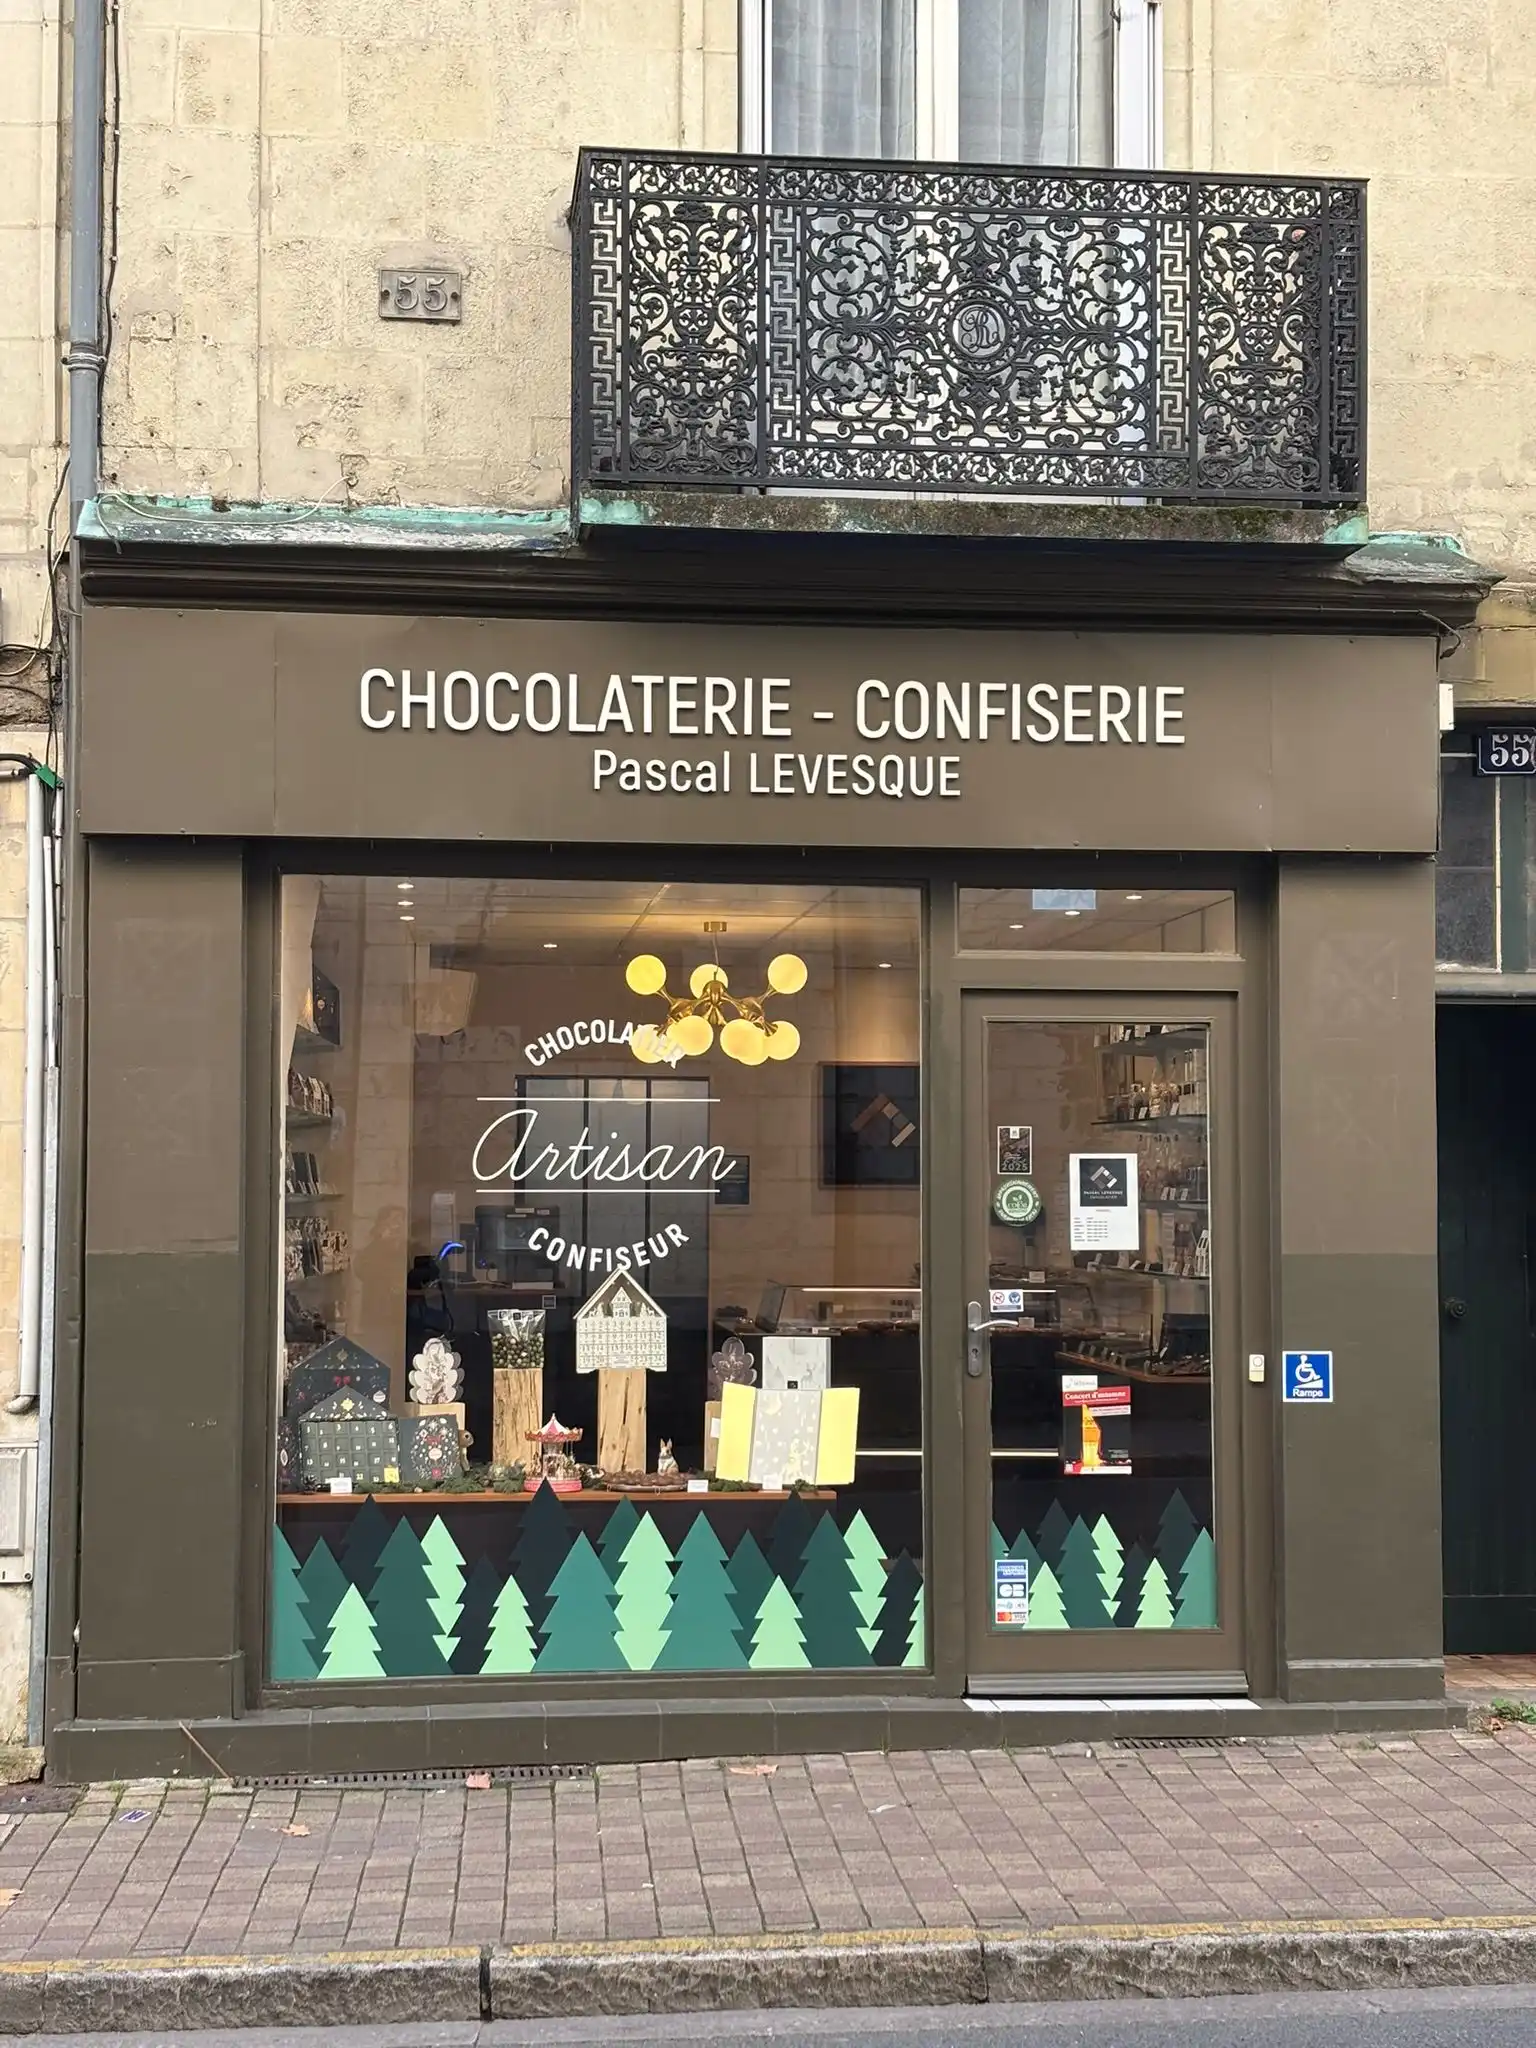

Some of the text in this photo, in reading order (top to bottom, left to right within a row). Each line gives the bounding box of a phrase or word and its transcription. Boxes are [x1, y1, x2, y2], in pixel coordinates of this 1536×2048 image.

[394, 275, 447, 312] 55
[361, 669, 791, 735] CHOCOLATERIE
[857, 680, 1184, 742] CONFISERIE
[1490, 734, 1530, 767] 55
[595, 750, 960, 797] Pascal LEVESQUE
[472, 1108, 737, 1181] Artisan
[1001, 1161, 1028, 1171] 2025
[527, 1223, 690, 1272] CONFISEUR
[1293, 1388, 1323, 1398] Rampe
